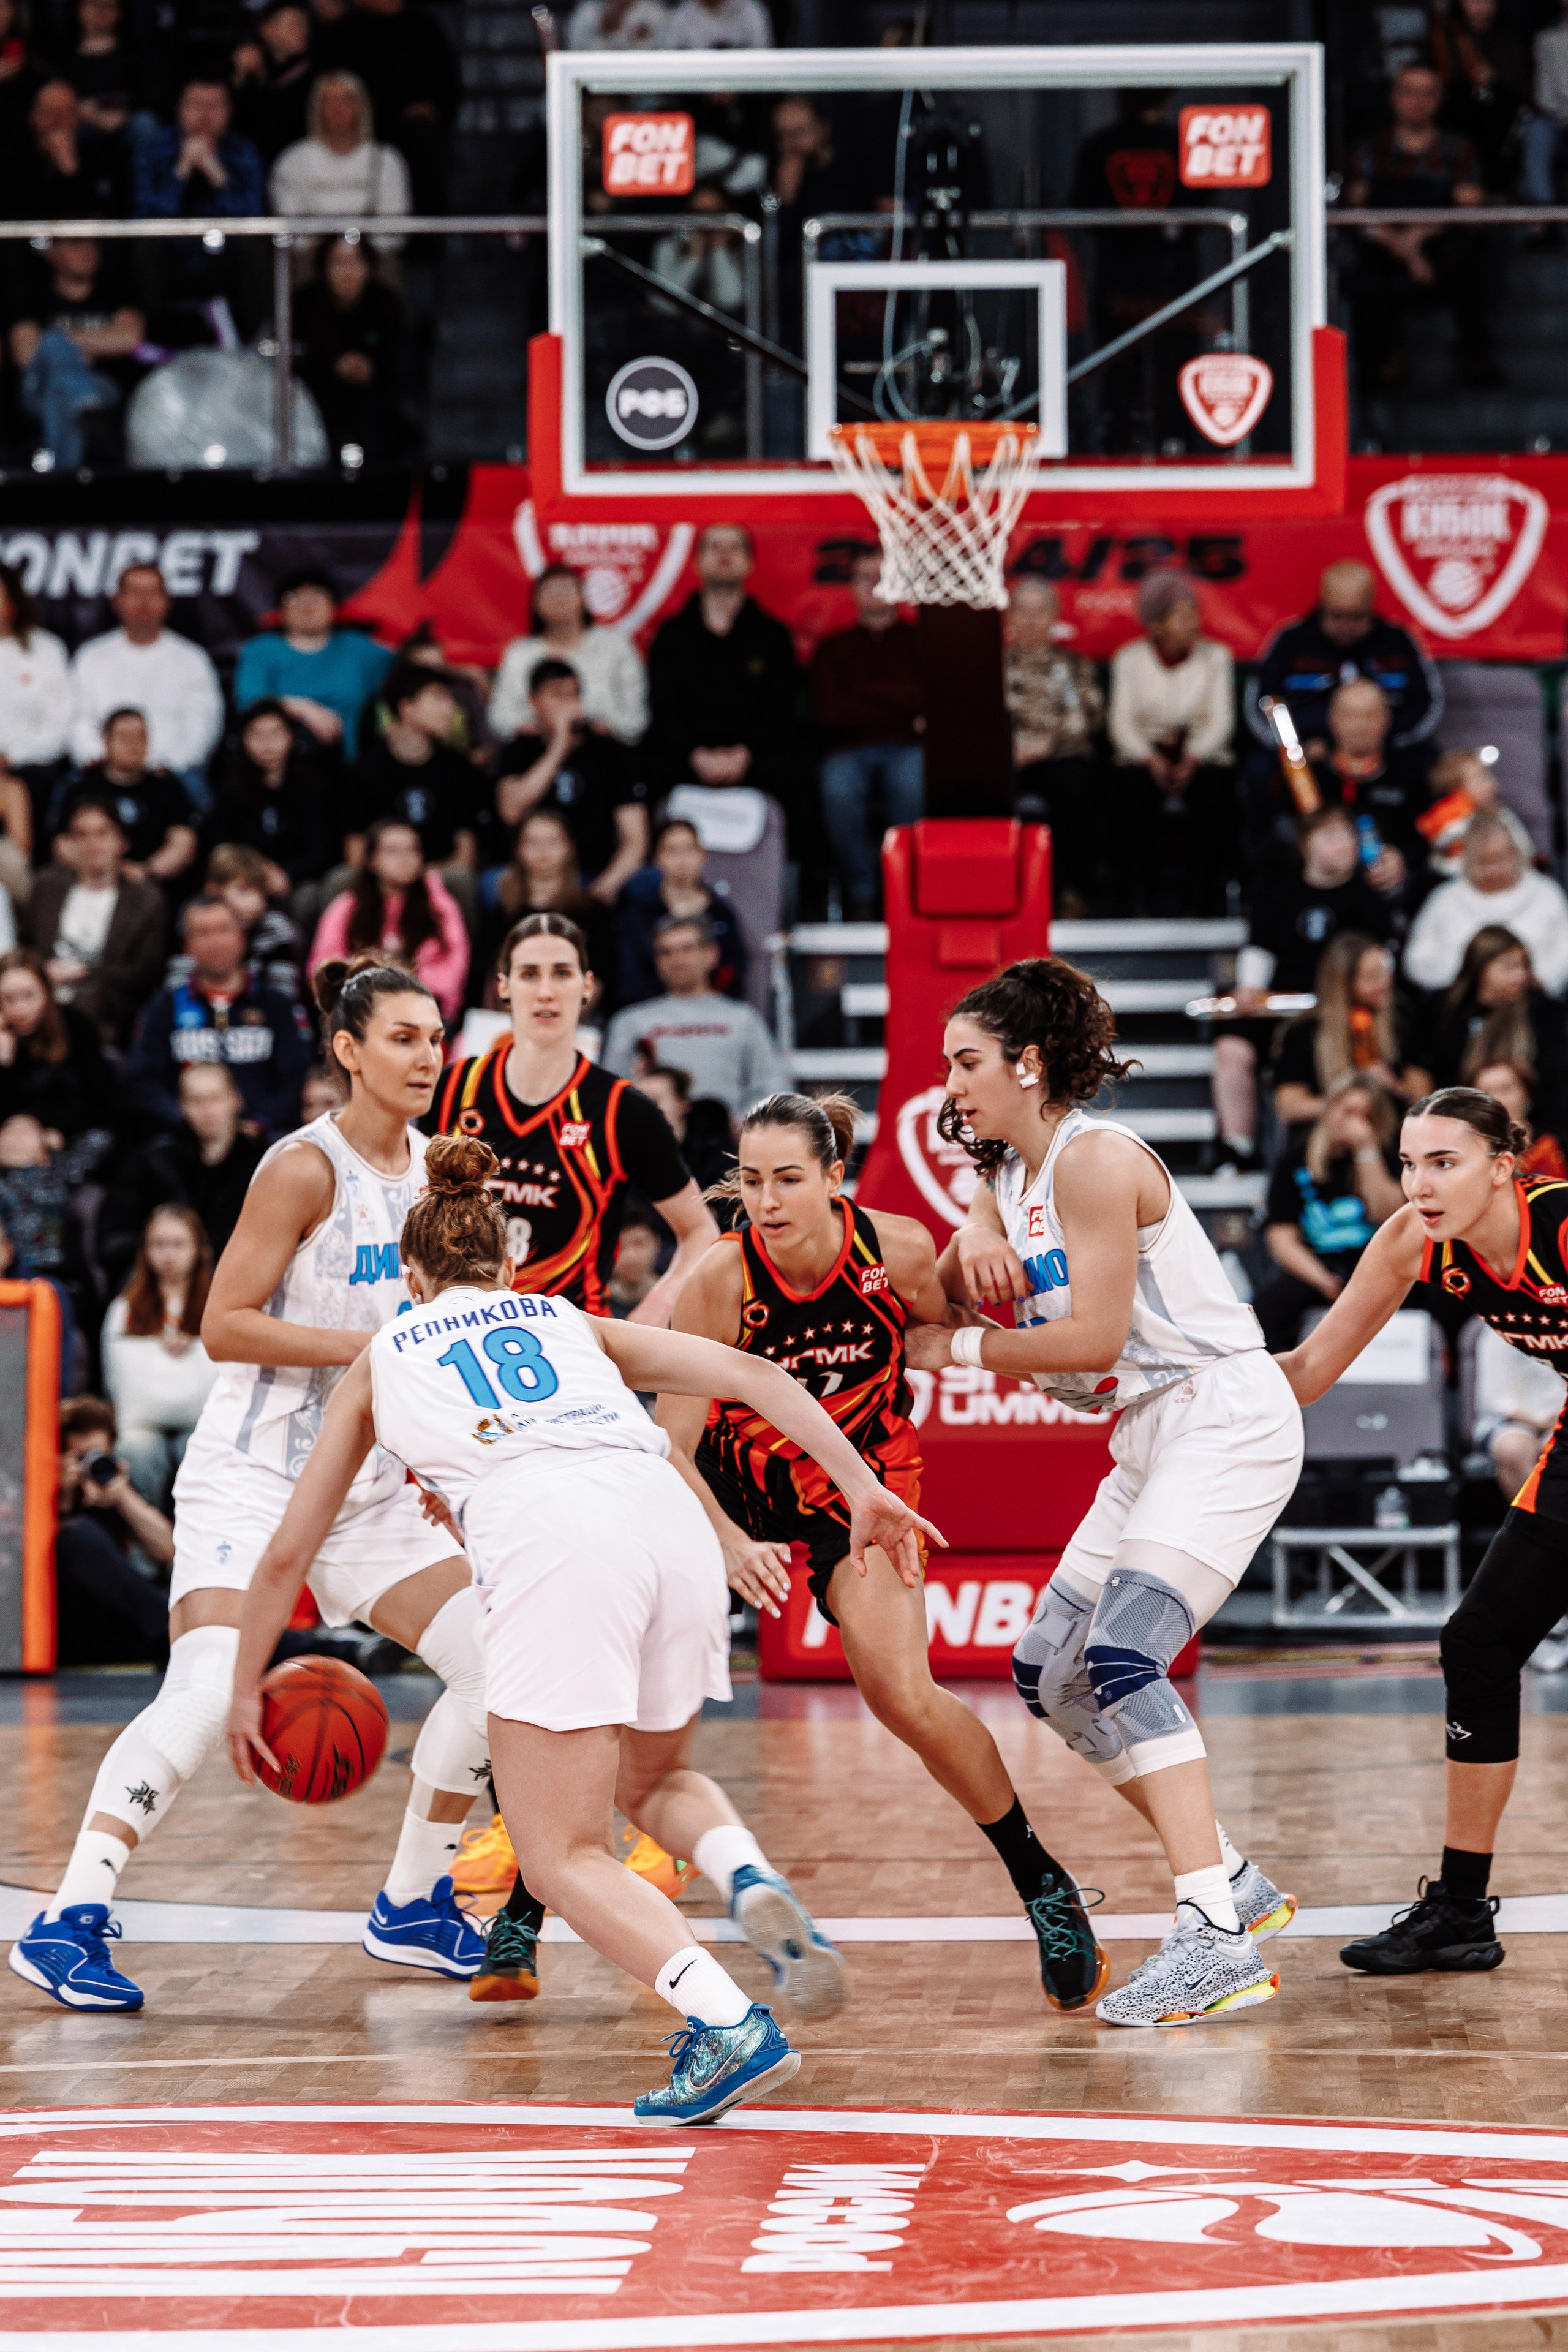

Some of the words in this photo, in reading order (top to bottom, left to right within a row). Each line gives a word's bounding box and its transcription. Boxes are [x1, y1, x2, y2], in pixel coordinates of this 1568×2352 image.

[609, 123, 688, 152] FON
[1186, 113, 1265, 145] FON
[609, 153, 688, 184] BET
[1186, 145, 1265, 176] BET
[1539, 1287, 1566, 1297] FON
[392, 1298, 558, 1353] РЕПНИКОВА
[437, 1325, 559, 1409] 18
[741, 2163, 925, 2273] РОССИИ
